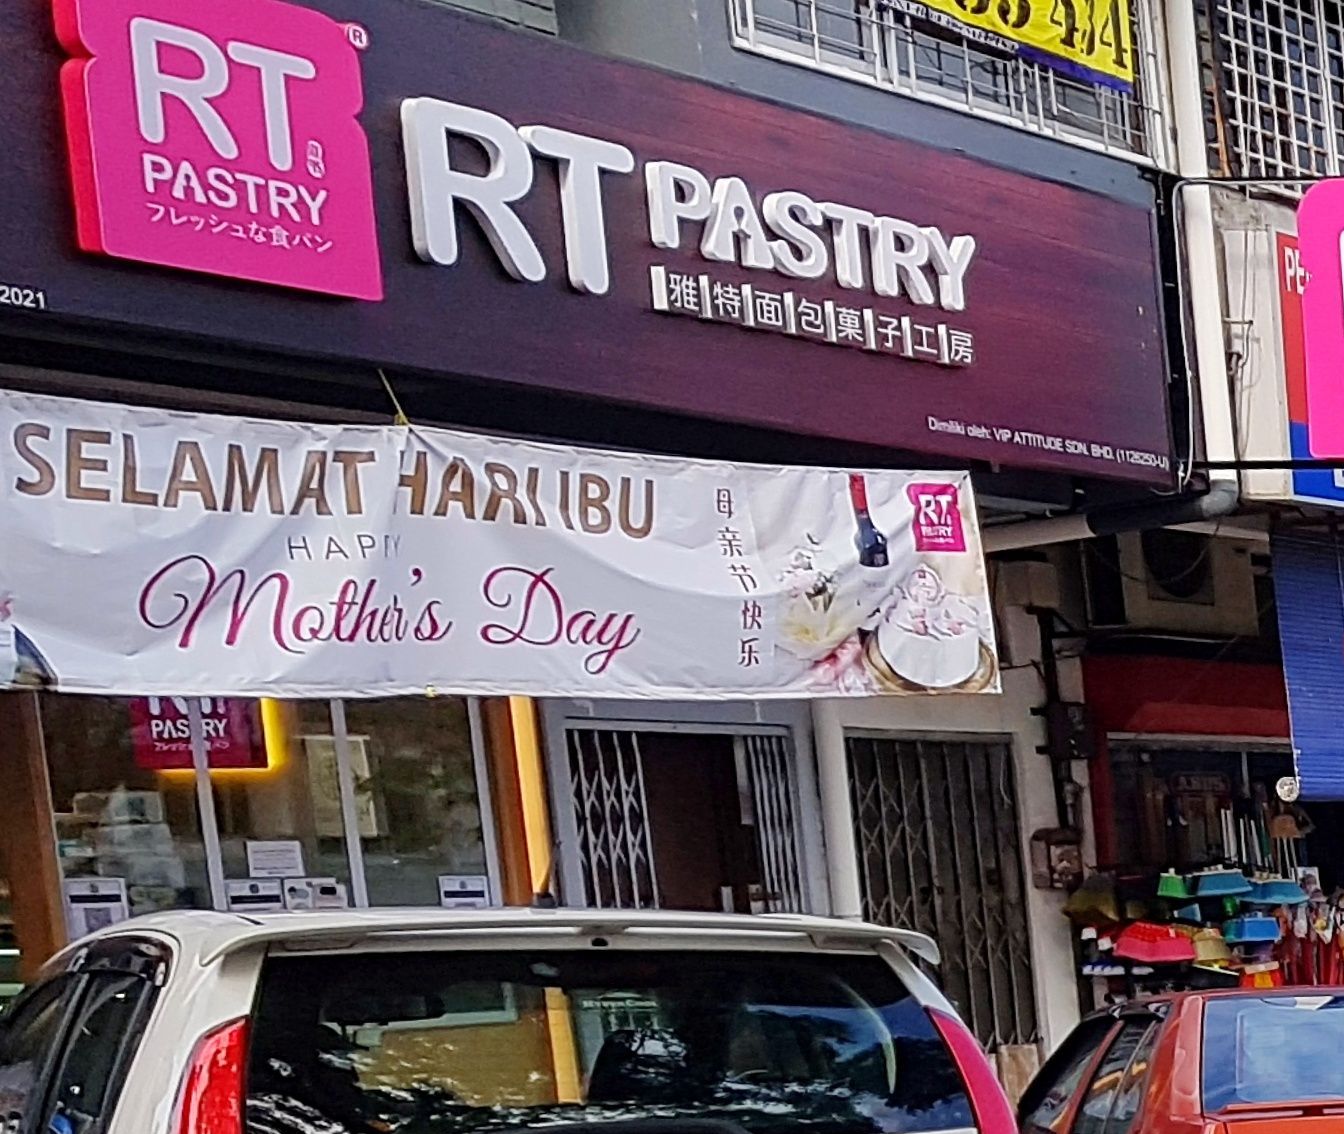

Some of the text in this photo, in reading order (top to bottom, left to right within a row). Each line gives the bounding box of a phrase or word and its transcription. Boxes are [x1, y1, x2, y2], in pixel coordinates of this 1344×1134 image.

[129, 16, 315, 171] RT
[142, 153, 328, 226] PASTRY
[400, 97, 634, 295] RT
[645, 161, 976, 311] PASTRY
[0, 285, 45, 310] 2021
[13, 422, 655, 540] SELAMAT HARI IBU
[992, 428, 1011, 443] VIP
[1012, 431, 1064, 453] ATTITUDE
[1065, 441, 1089, 456] SDN.
[1091, 444, 1115, 460] BHD.
[917, 494, 953, 525] RT
[138, 554, 641, 675] Mother's Day
[715, 487, 763, 668] 母亲节快乐
[150, 719, 228, 739] PASRY
